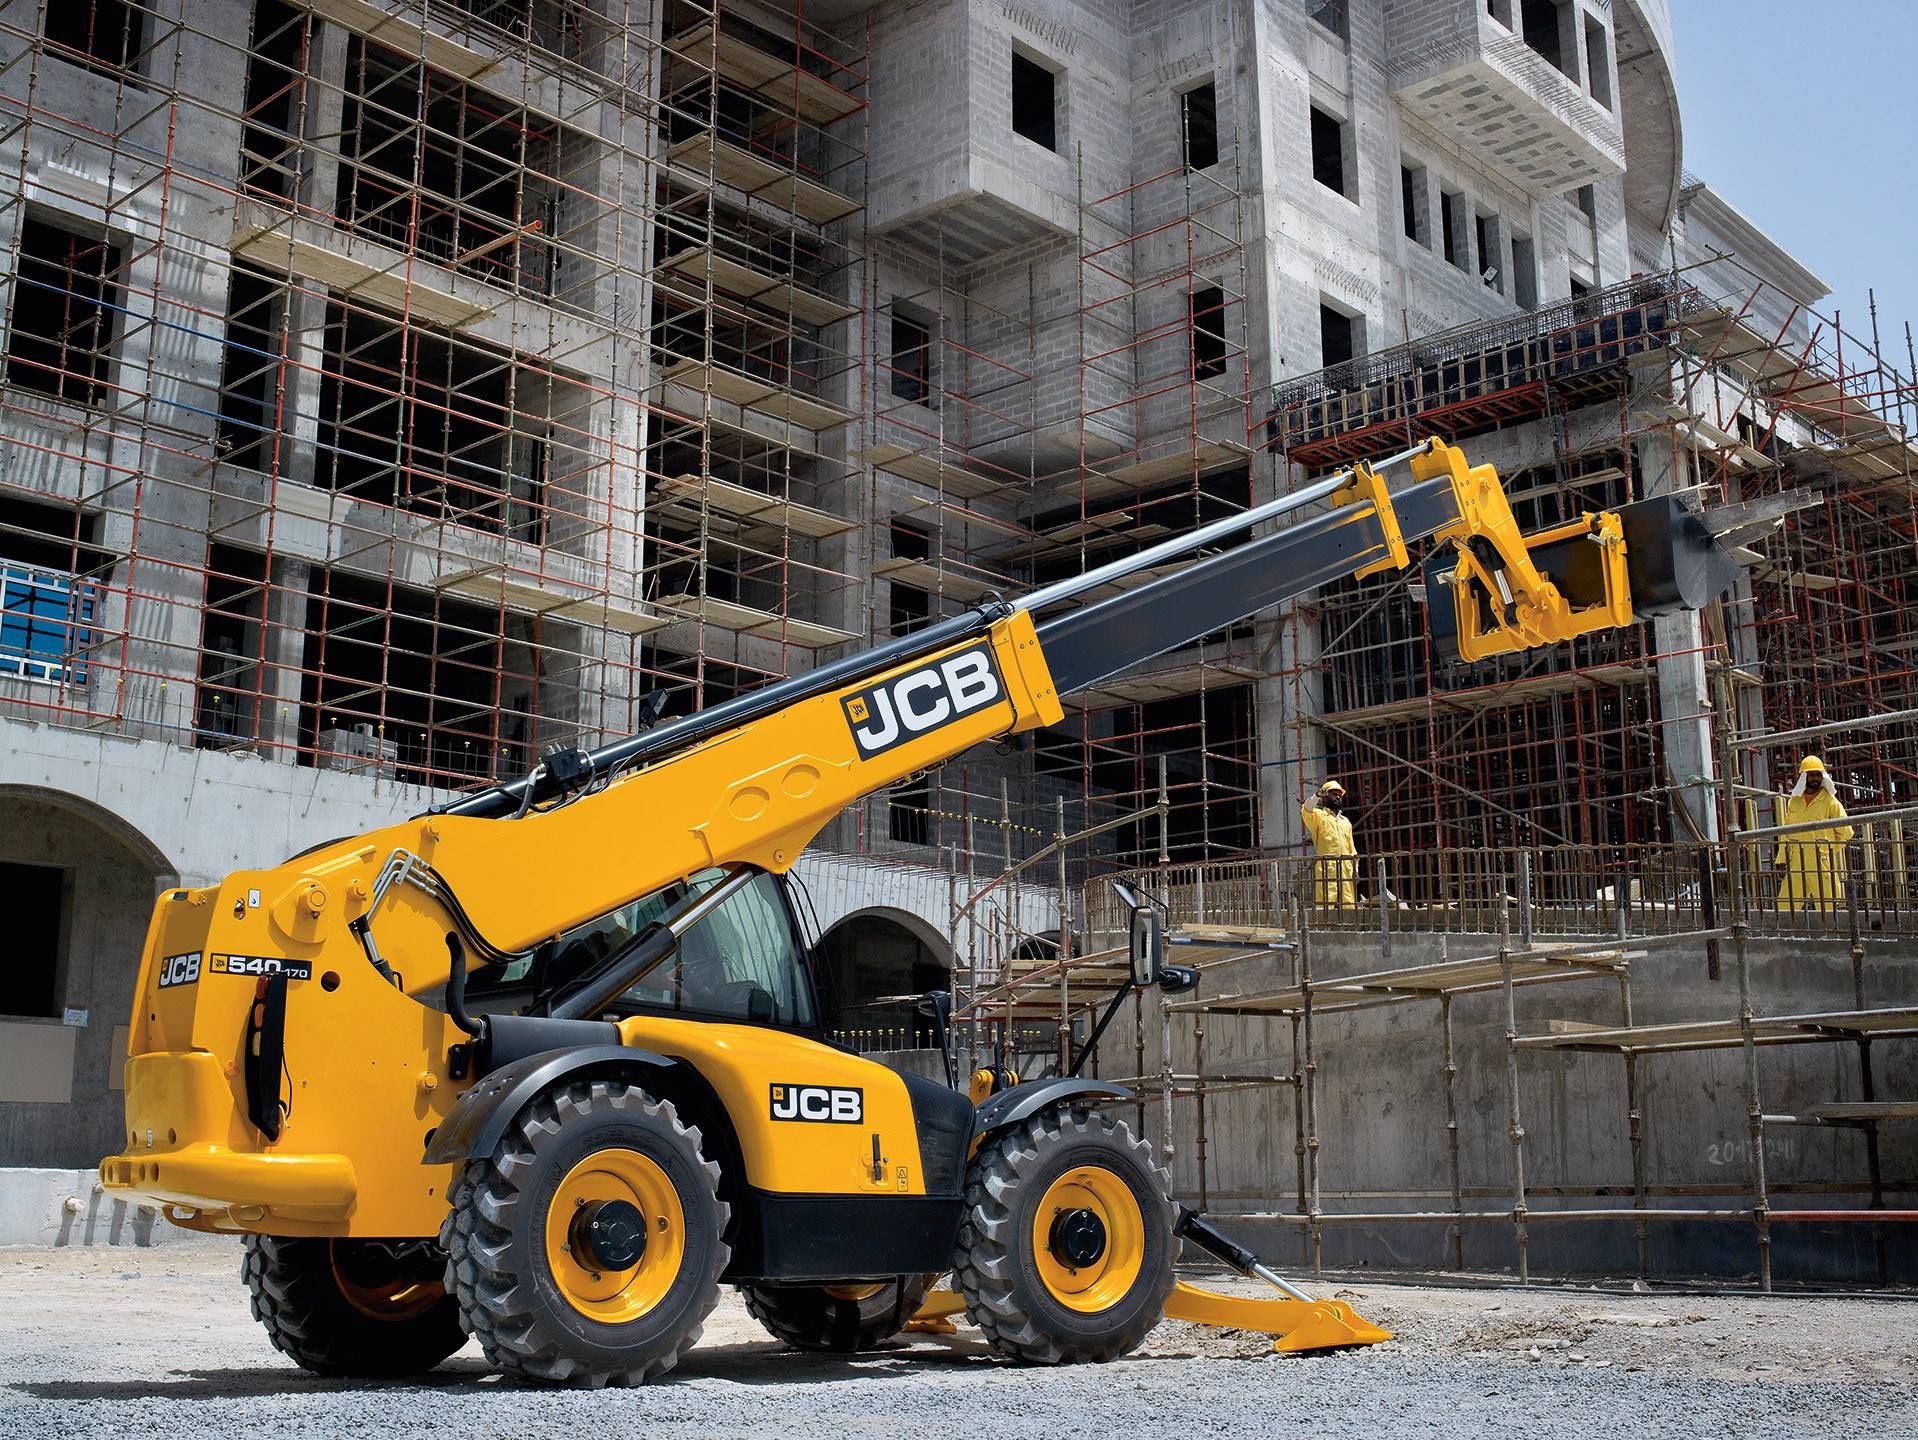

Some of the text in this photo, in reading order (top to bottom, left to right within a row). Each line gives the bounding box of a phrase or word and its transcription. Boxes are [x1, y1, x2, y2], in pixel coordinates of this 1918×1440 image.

[856, 650, 998, 750] JCB
[160, 953, 201, 986] JCB
[773, 1087, 861, 1122] JCB
